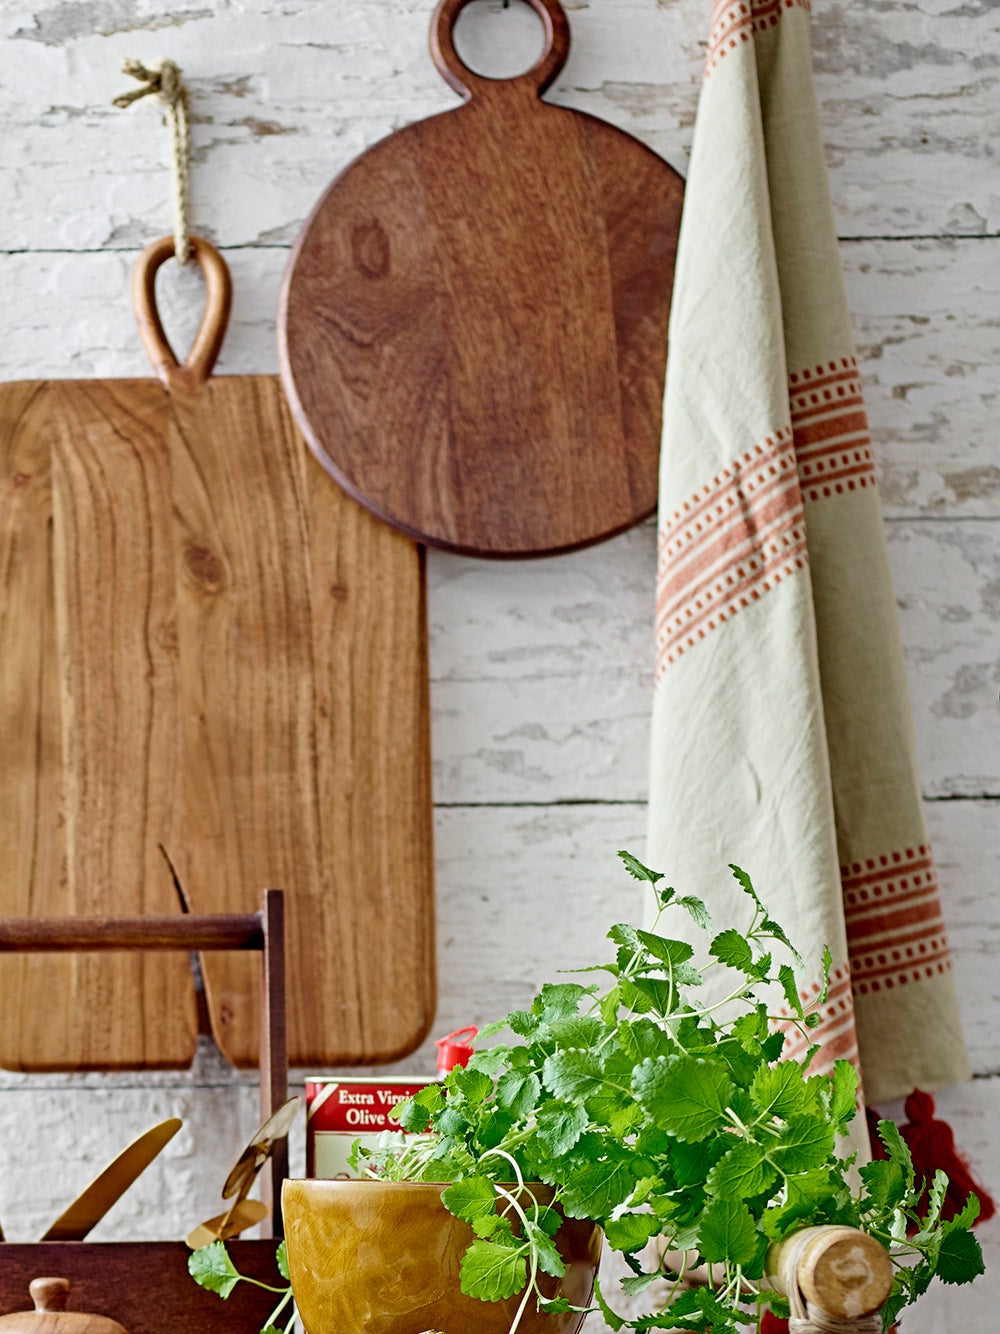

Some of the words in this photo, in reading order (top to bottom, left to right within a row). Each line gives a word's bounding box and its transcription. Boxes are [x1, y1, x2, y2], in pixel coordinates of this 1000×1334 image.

[338, 1089, 375, 1105] Extra
[377, 1090, 413, 1105] Viri
[346, 1107, 386, 1125] Olive
